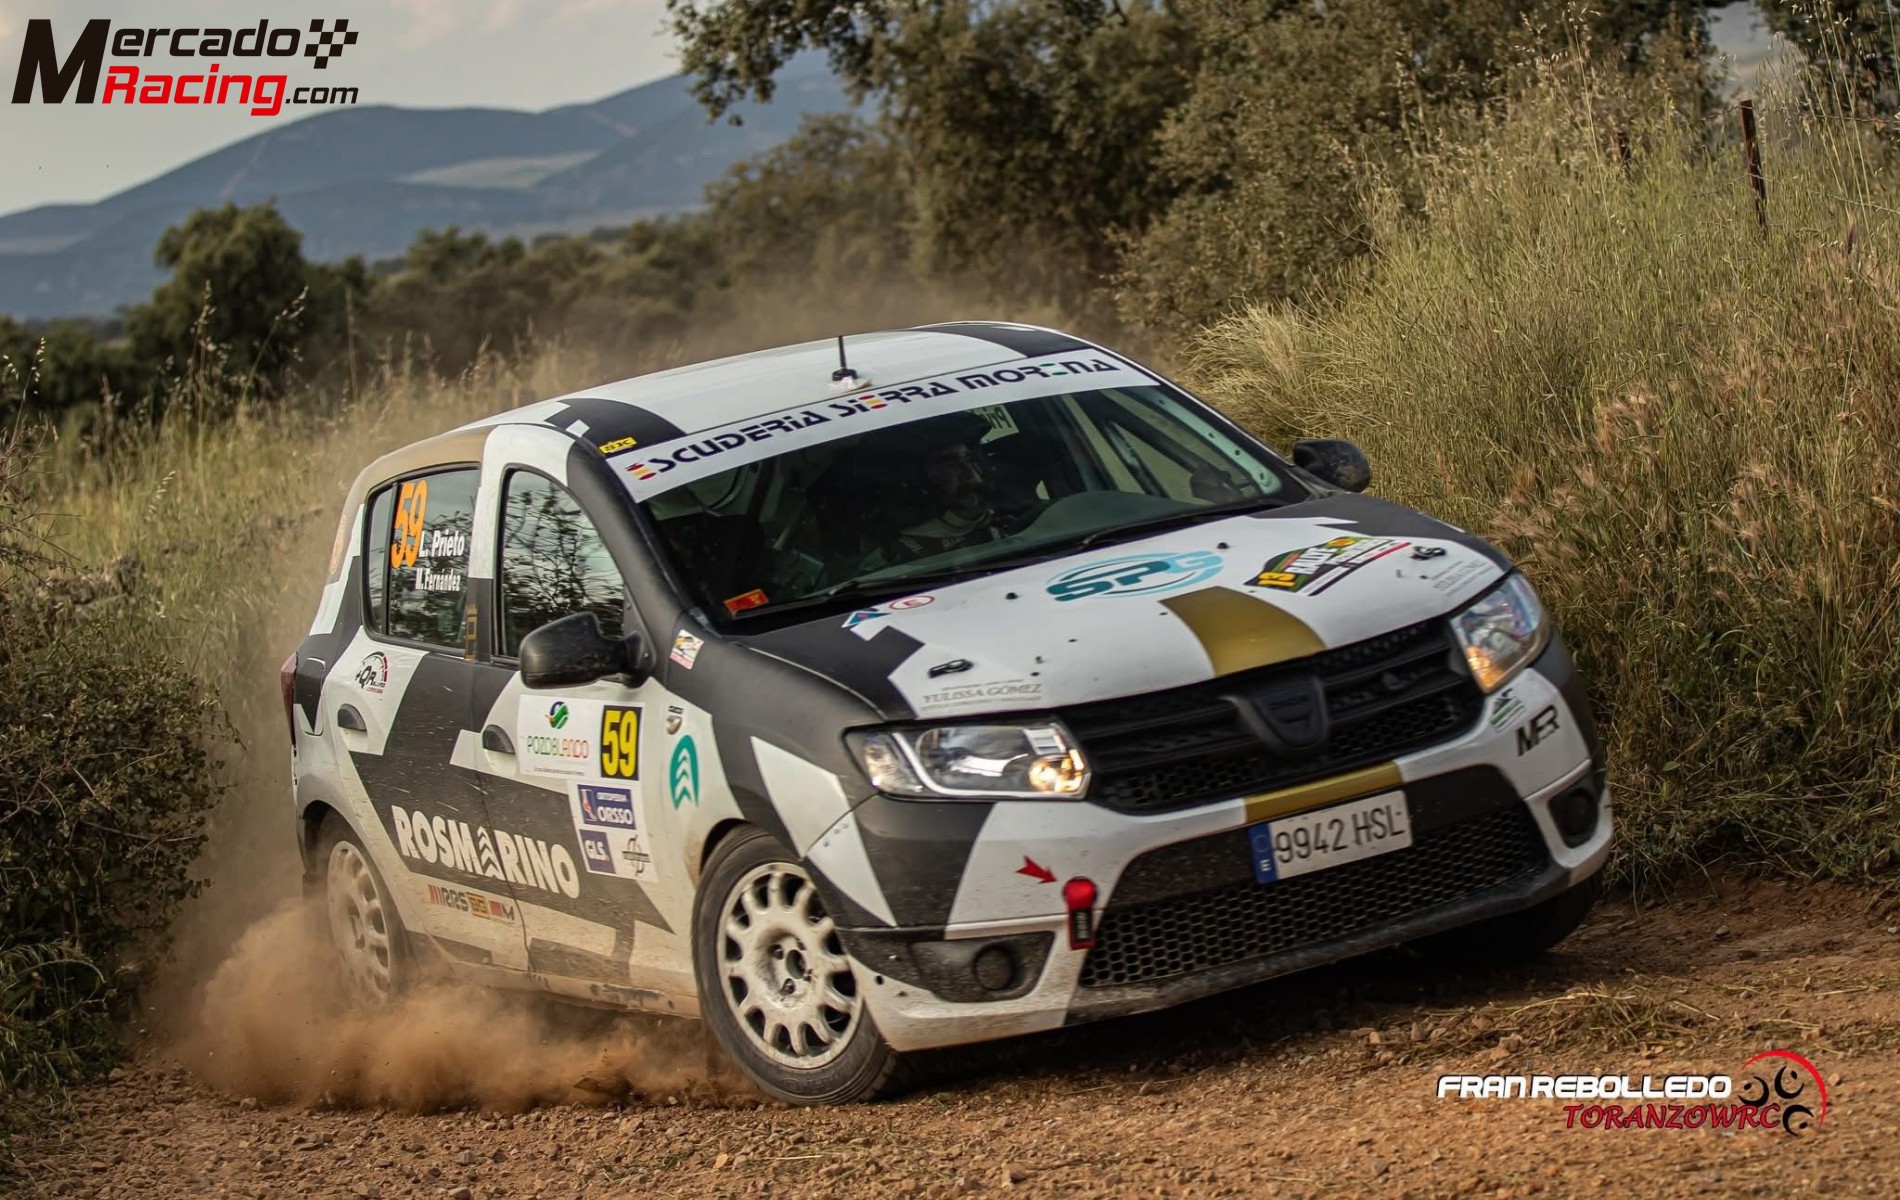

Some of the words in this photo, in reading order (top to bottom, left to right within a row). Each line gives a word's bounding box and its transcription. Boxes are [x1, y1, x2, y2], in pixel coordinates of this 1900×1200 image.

[391, 480, 428, 569] 59
[419, 530, 429, 558] L.
[432, 529, 466, 558] Prieto
[1046, 550, 1223, 602] SPG
[602, 710, 638, 777] 59
[391, 804, 580, 899] ROSMARINO
[1274, 818, 1349, 864] 9942
[1352, 804, 1406, 846] HSL
[1260, 859, 1272, 872] E
